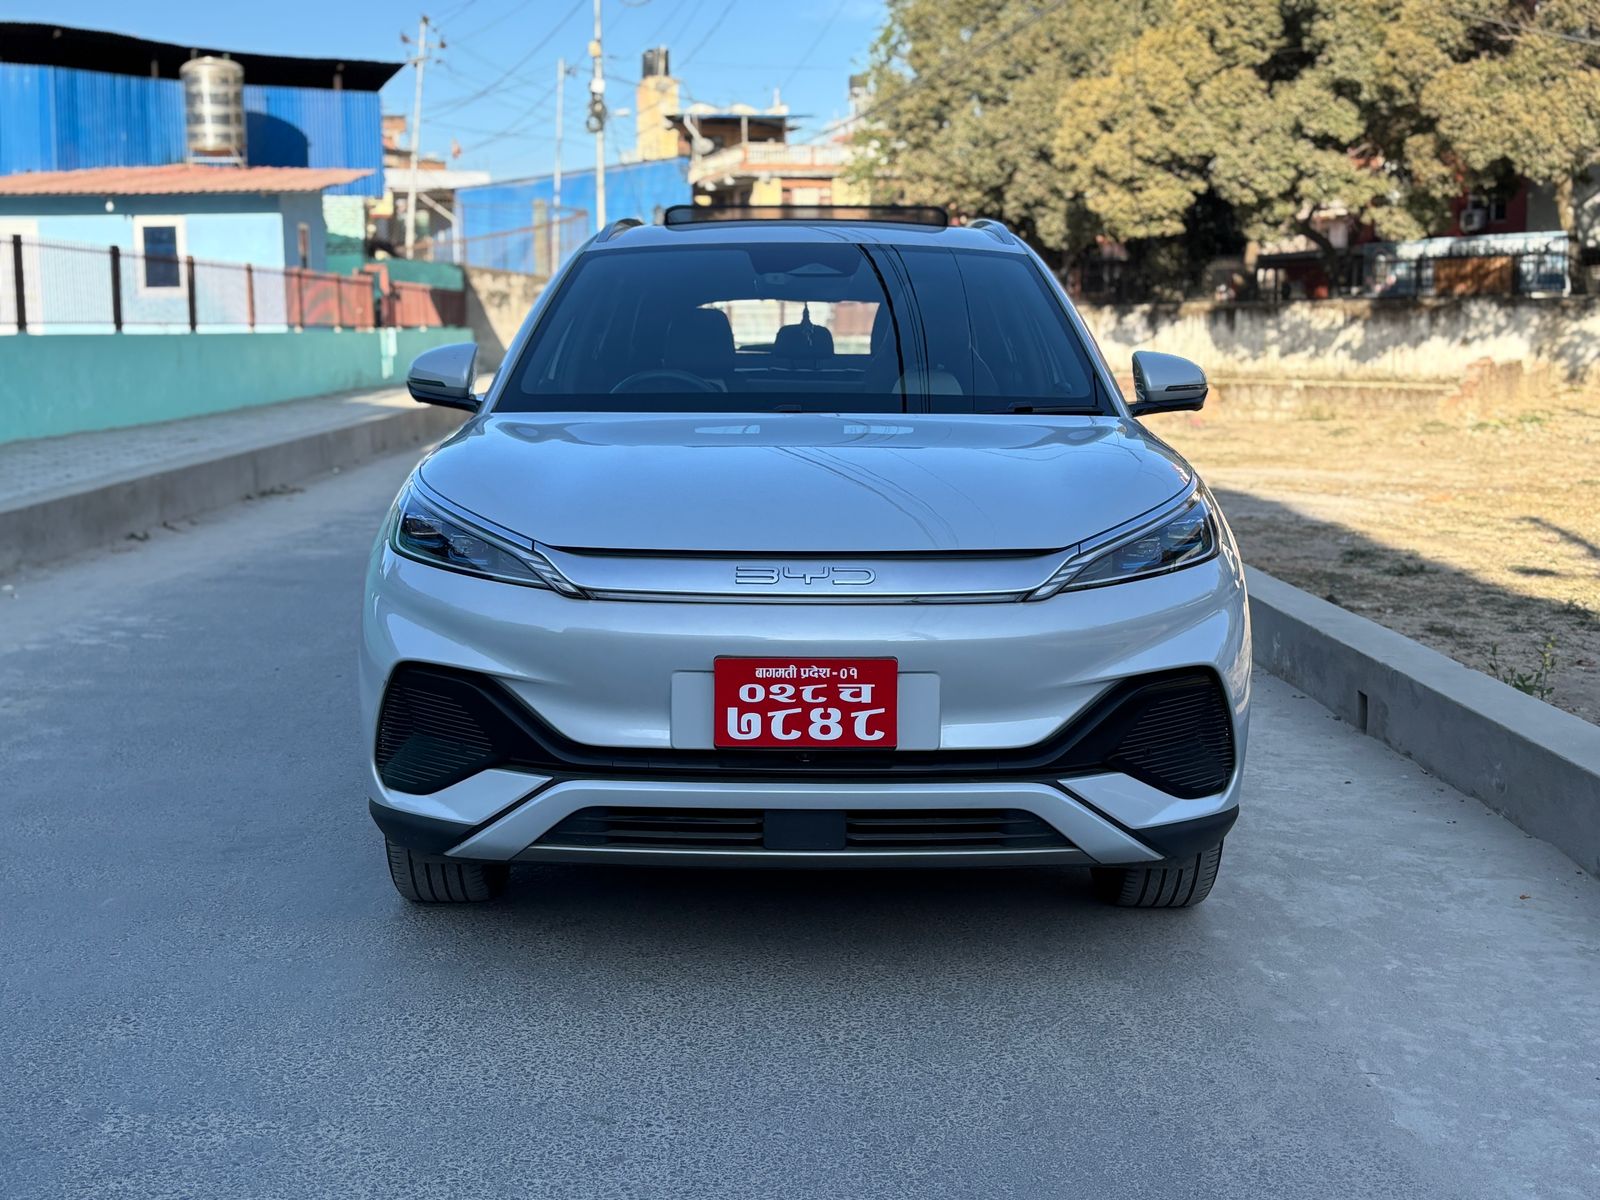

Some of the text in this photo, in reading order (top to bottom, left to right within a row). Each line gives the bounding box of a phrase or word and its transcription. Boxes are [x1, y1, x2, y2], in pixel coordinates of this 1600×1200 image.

[735, 566, 876, 585] BYD
[755, 664, 797, 679] बागमती
[738, 683, 876, 704] ०२८ च
[727, 707, 886, 741] ७८४८
